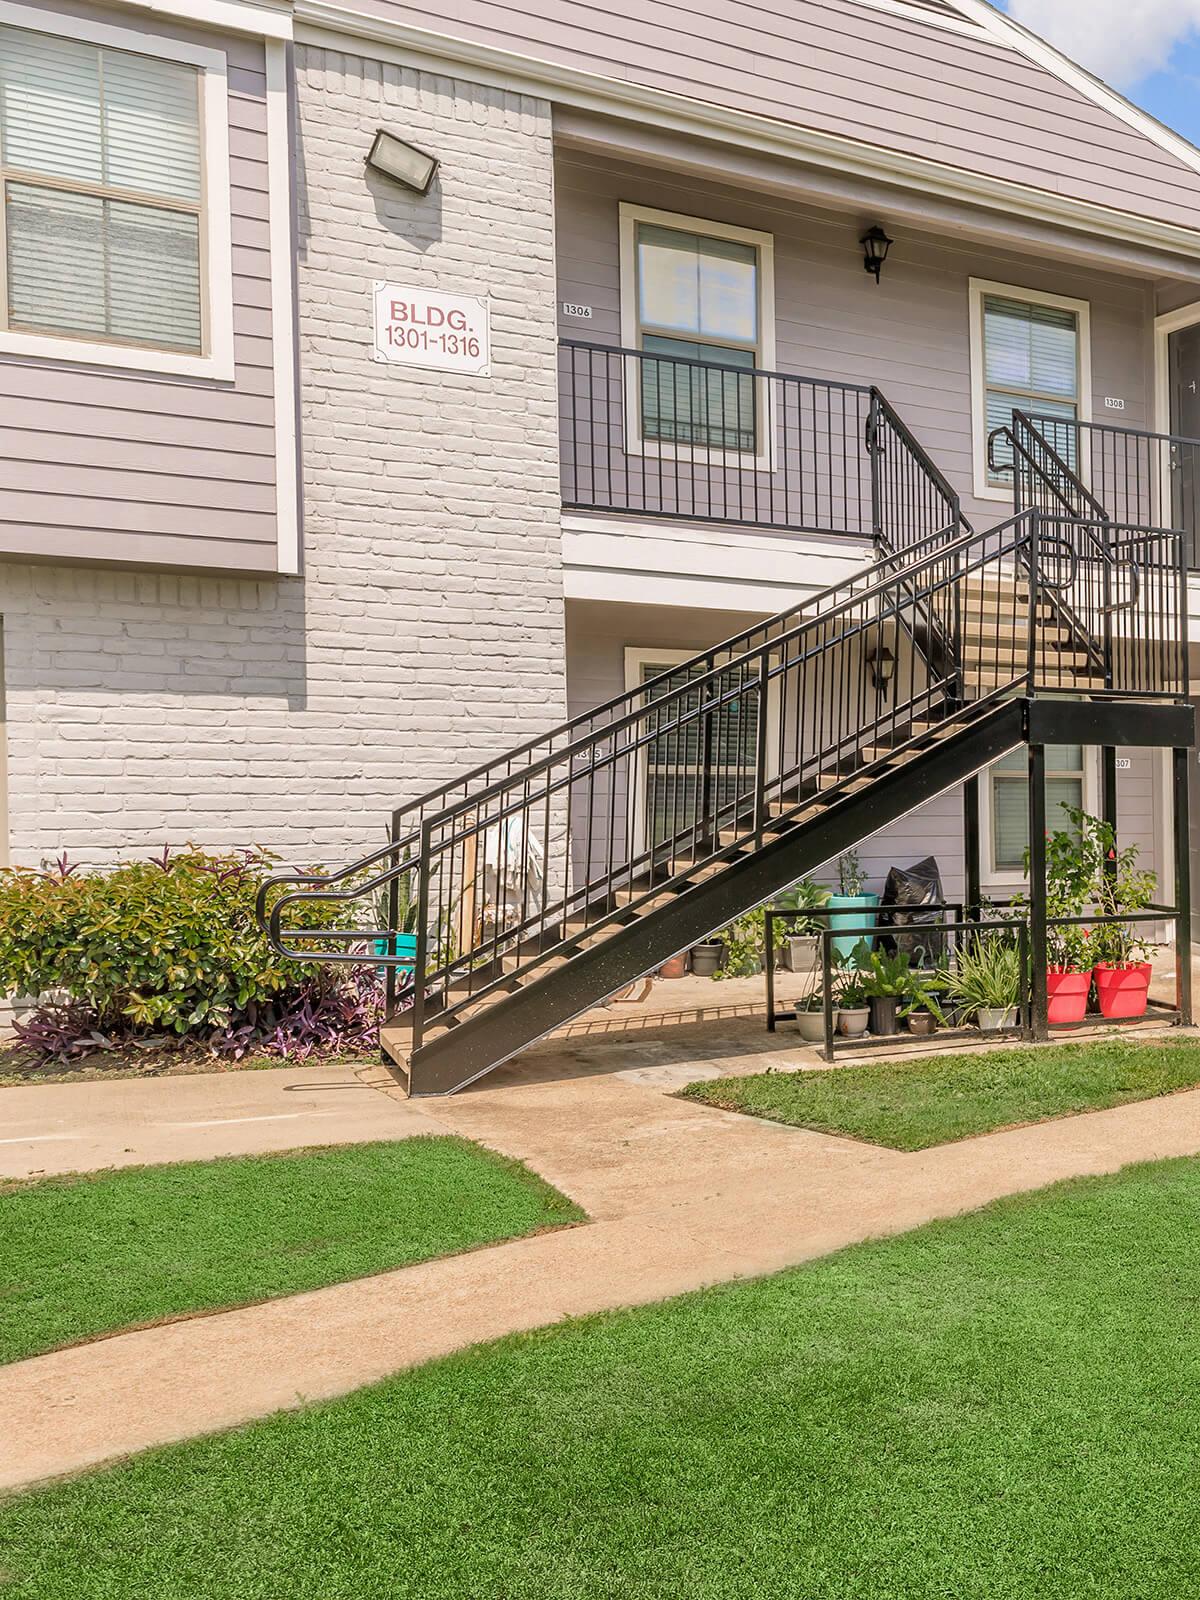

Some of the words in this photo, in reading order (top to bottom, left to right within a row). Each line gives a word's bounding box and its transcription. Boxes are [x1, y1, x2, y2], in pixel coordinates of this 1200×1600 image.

[390, 300, 474, 332] BLDG.
[565, 304, 590, 317] 1306
[385, 325, 480, 358] 1301-1316
[1106, 398, 1123, 408] 1308
[577, 749, 601, 759] 35
